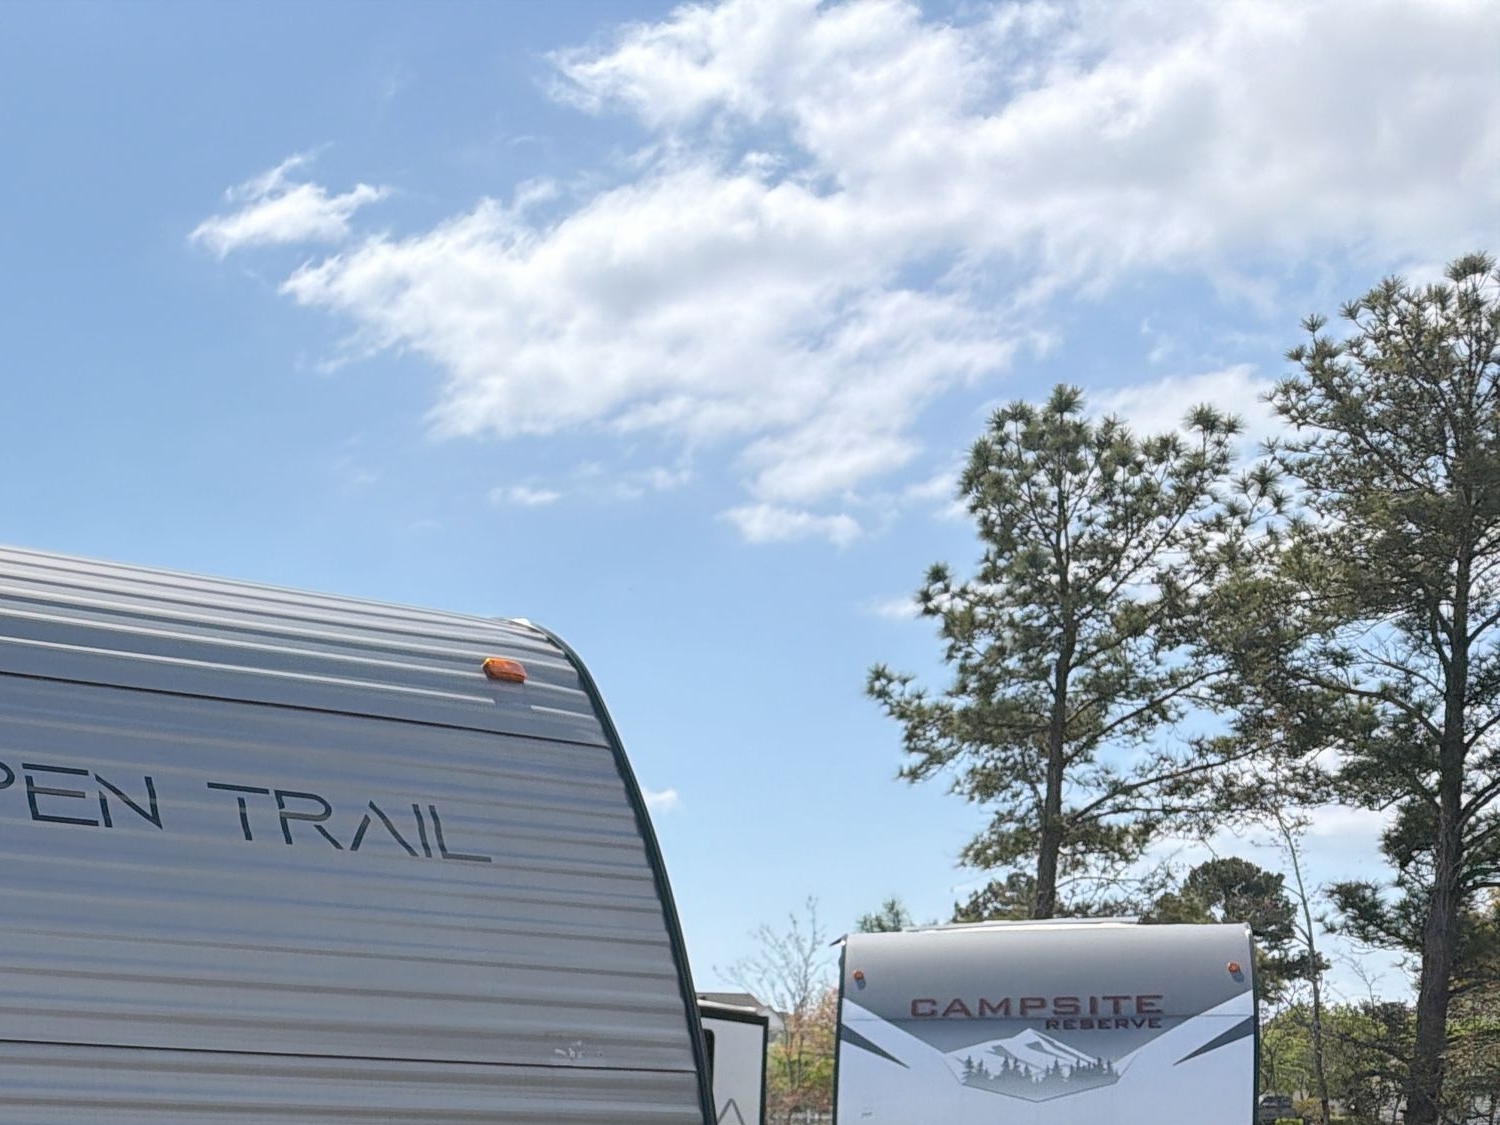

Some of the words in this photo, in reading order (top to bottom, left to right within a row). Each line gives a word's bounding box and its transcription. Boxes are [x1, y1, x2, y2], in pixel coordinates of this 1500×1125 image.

[207, 781, 493, 863] TRAIL
[910, 994, 1165, 1018] CAMPSITE
[1045, 1017, 1163, 1031] RESERVE
